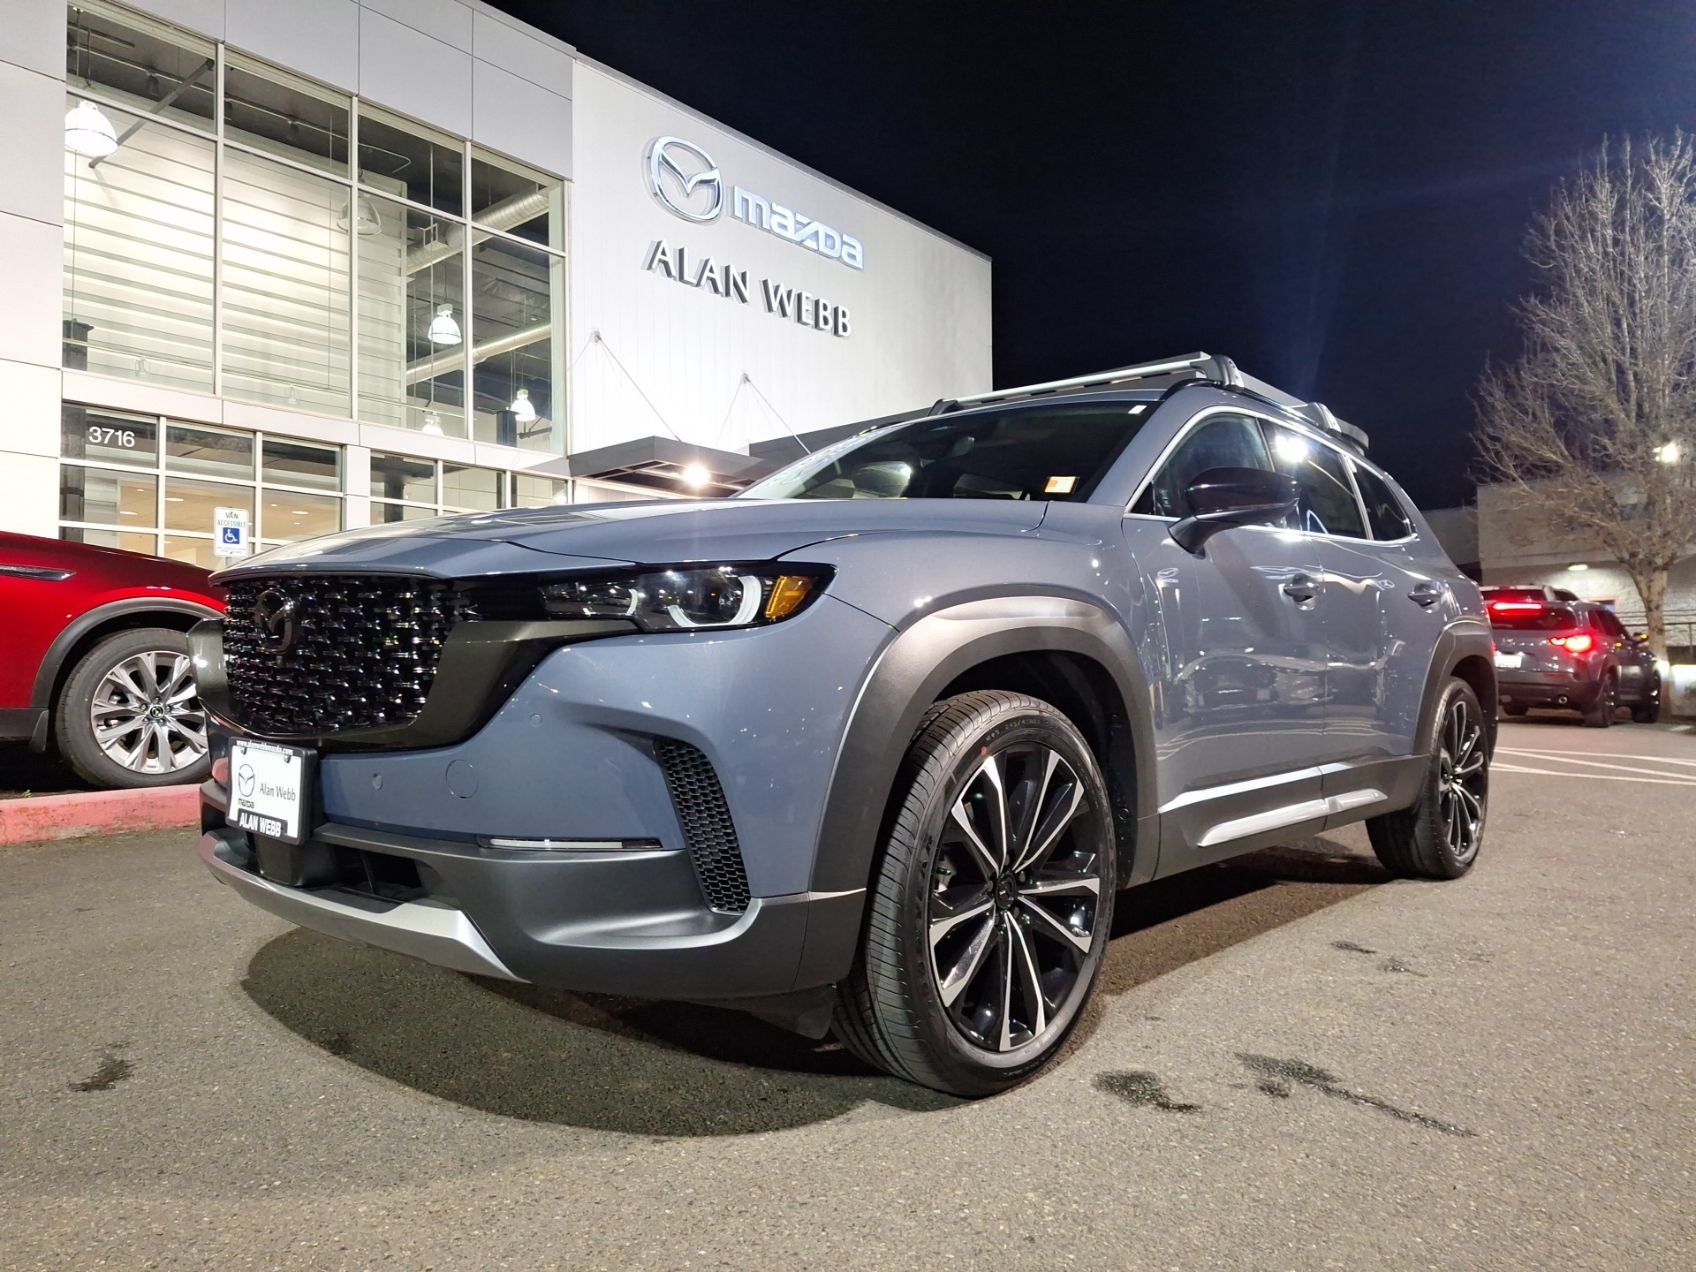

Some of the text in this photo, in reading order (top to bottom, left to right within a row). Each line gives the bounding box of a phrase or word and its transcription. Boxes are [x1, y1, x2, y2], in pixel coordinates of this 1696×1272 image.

[733, 184, 863, 270] mazda
[646, 239, 852, 338] ALAN WEBB
[88, 426, 135, 448] 3716
[225, 511, 239, 519] VAN
[260, 783, 296, 802] Alan Webb
[239, 812, 281, 838] ALAN WEBB
